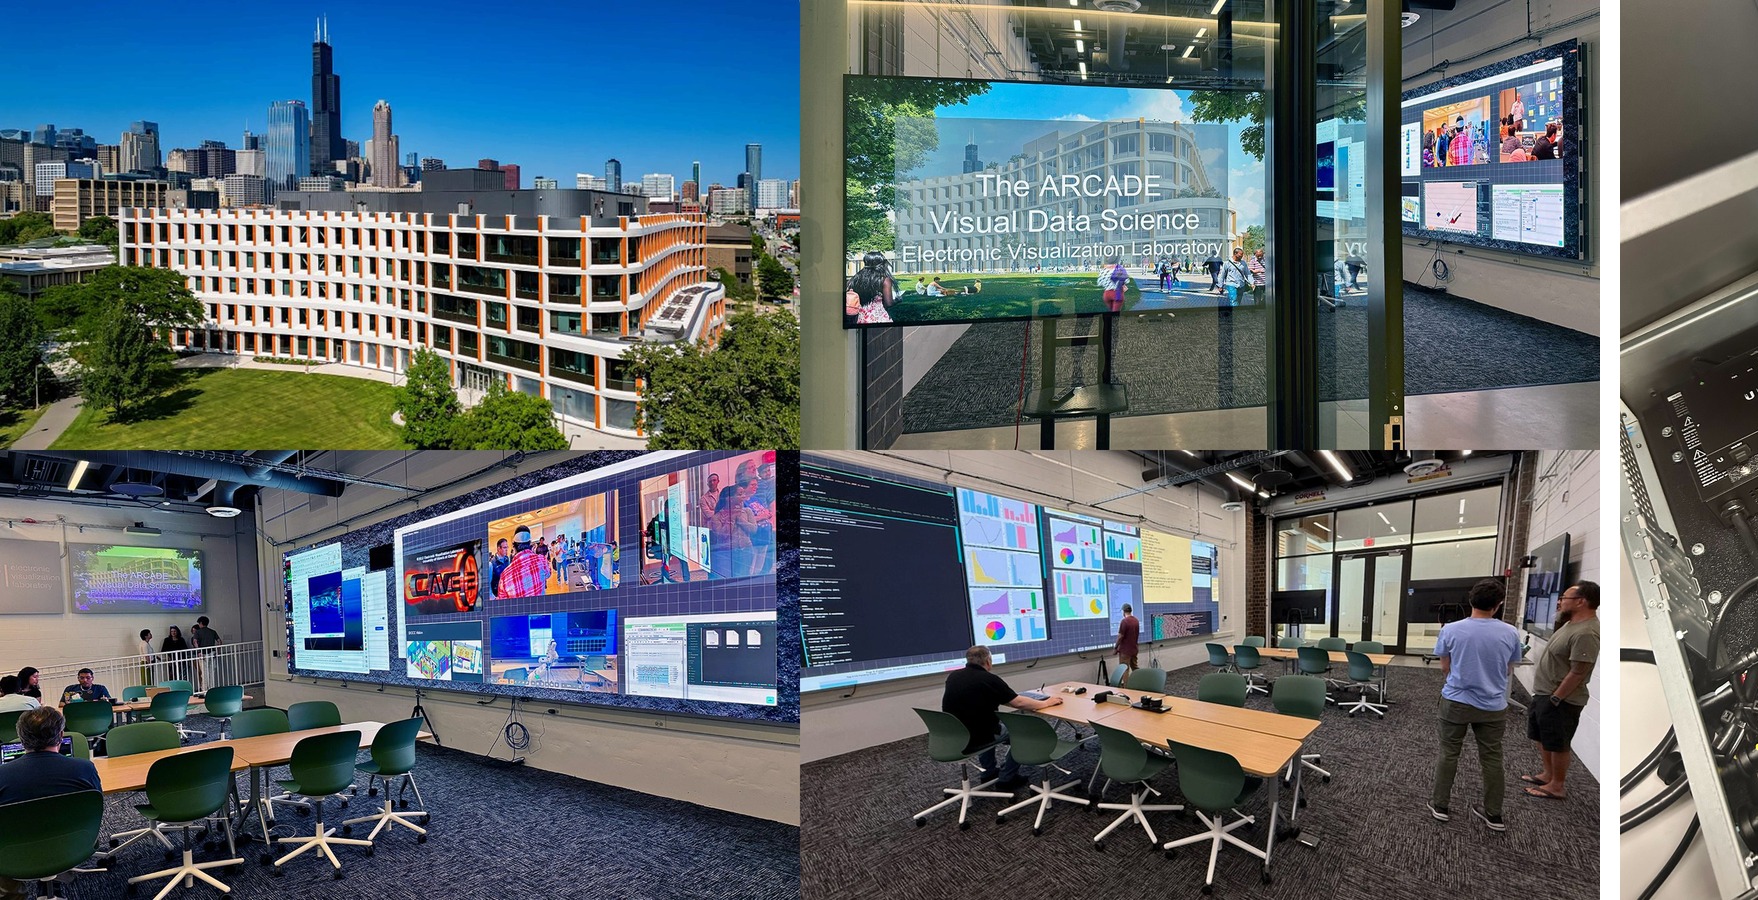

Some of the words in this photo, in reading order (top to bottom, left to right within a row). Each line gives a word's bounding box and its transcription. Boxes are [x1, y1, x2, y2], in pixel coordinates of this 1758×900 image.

[976, 175, 1030, 197] The
[1039, 174, 1161, 197] ARCADE
[930, 211, 1016, 234] Visual
[1028, 209, 1091, 232] Data
[1100, 209, 1199, 231] Science
[903, 245, 1001, 263] Electronic
[1008, 242, 1125, 260] Visualization
[1132, 240, 1223, 258] Laboratory
[130, 572, 168, 580] ARCADE
